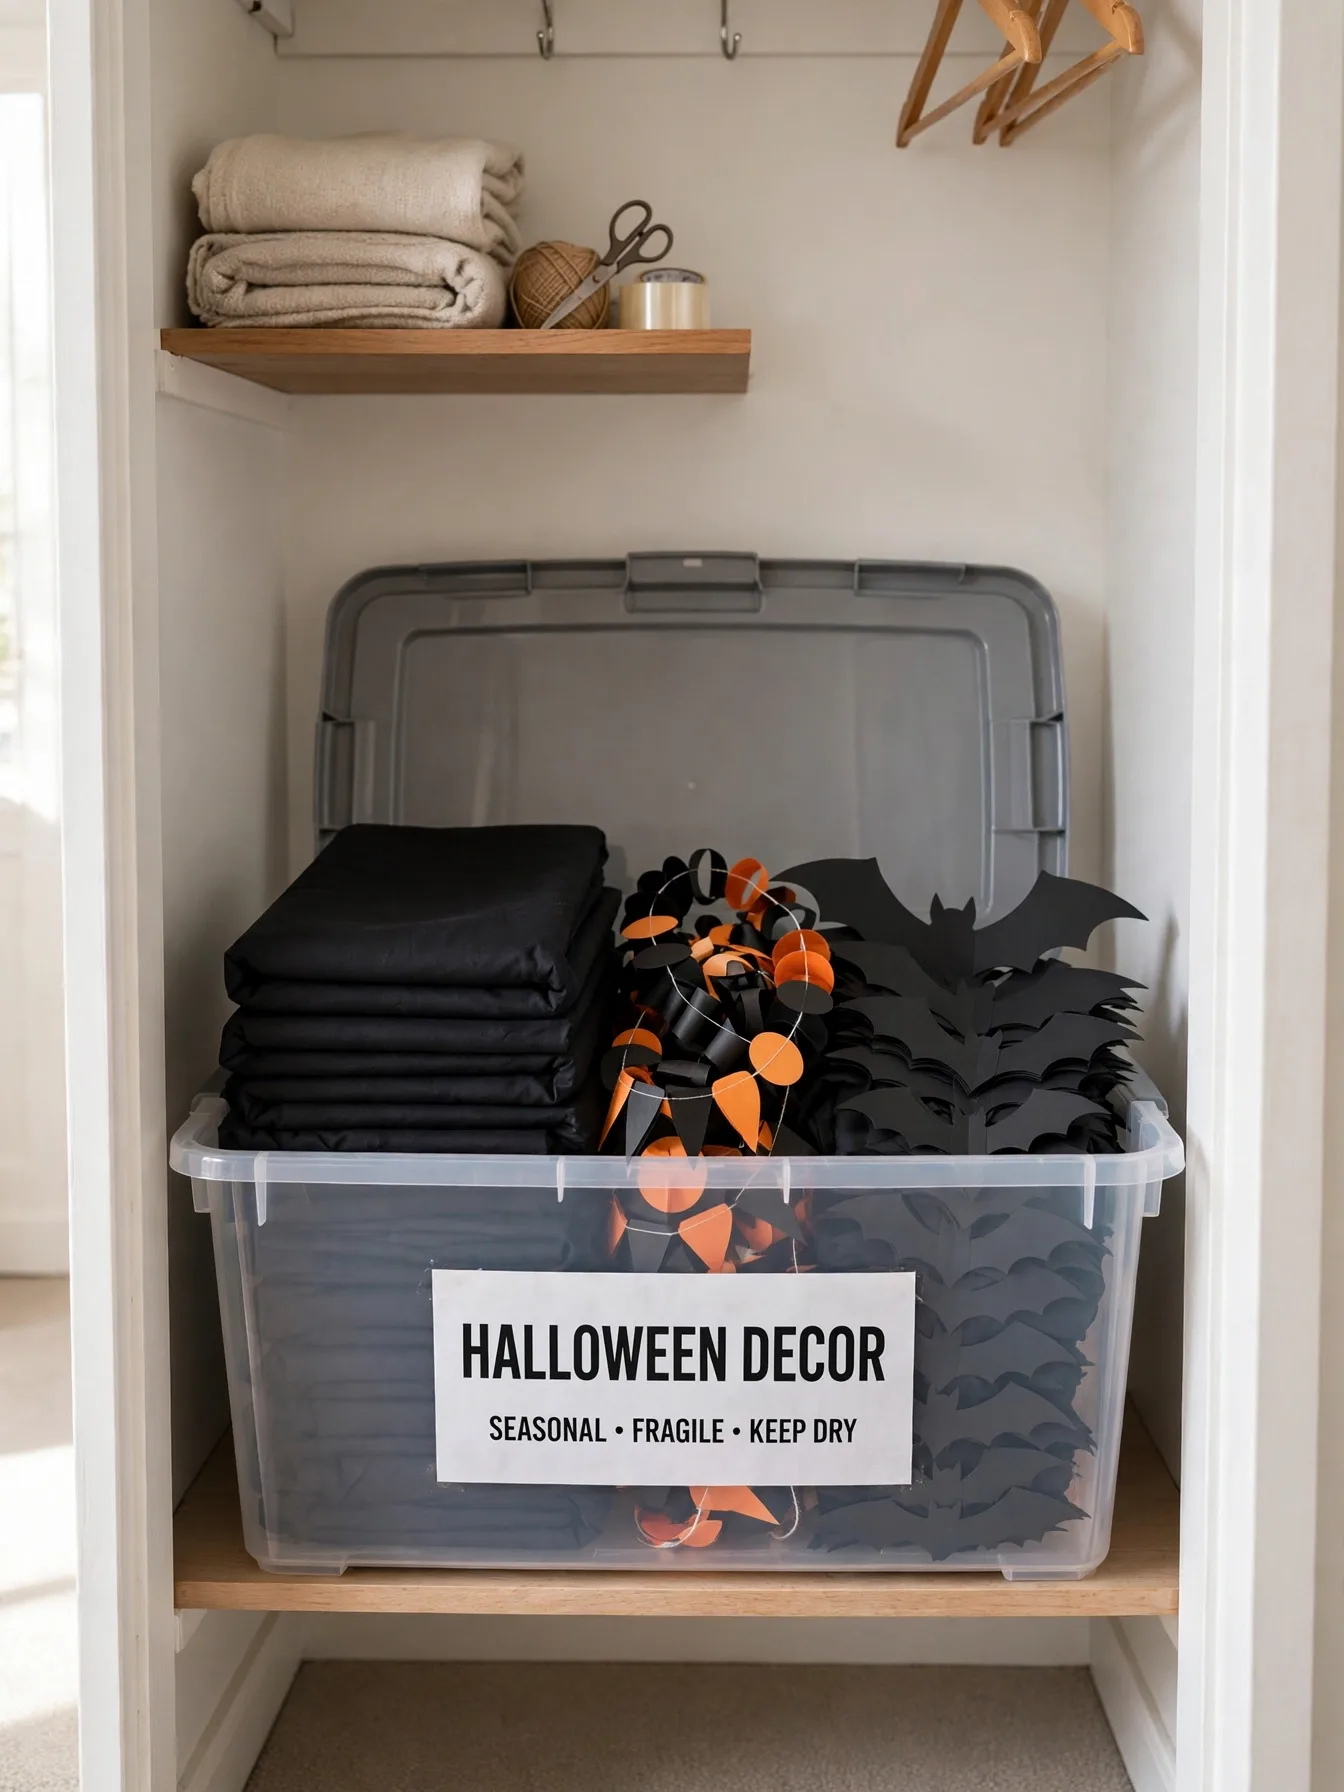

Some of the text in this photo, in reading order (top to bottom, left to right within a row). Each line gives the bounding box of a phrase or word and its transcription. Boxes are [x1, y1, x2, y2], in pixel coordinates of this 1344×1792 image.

[462, 1323, 886, 1382] HALLOWEEN DECOR
[489, 1415, 858, 1443] SEASONAL FRAGILE KEEP DRY
